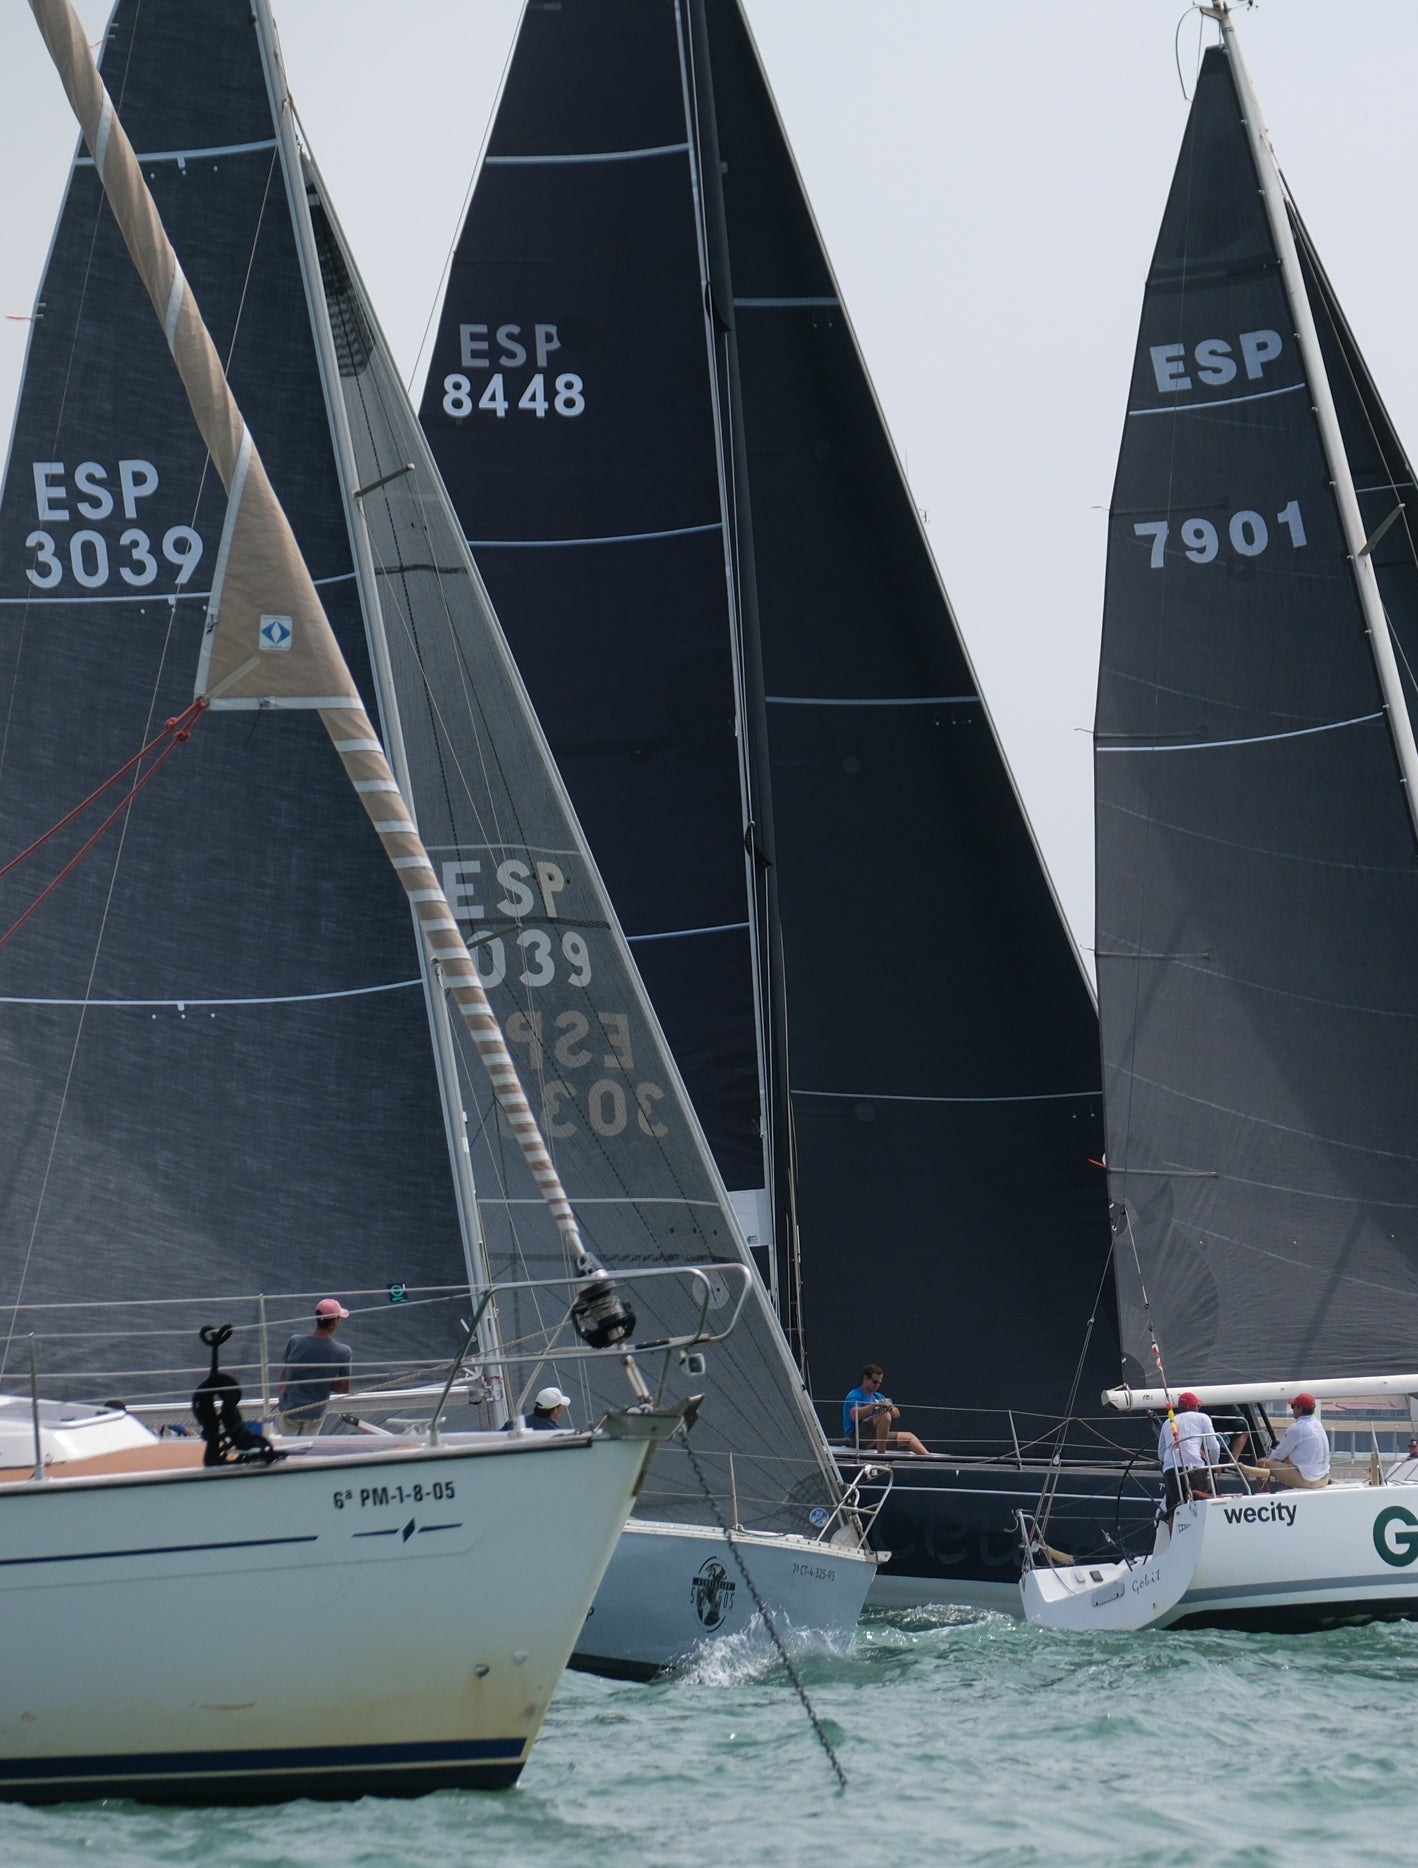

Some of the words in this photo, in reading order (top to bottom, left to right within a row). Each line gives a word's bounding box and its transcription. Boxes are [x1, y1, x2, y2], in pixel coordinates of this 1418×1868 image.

[460, 323, 562, 368] ESP
[1149, 329, 1283, 393] ESP
[442, 373, 585, 418] 8448
[31, 459, 159, 521] ESP
[24, 525, 203, 588] 3039
[1134, 501, 1309, 569] 7901
[443, 860, 564, 919] ESP
[458, 929, 592, 989] 039
[360, 1481, 456, 1508] PM-1-8-05
[1223, 1501, 1297, 1526] wecity
